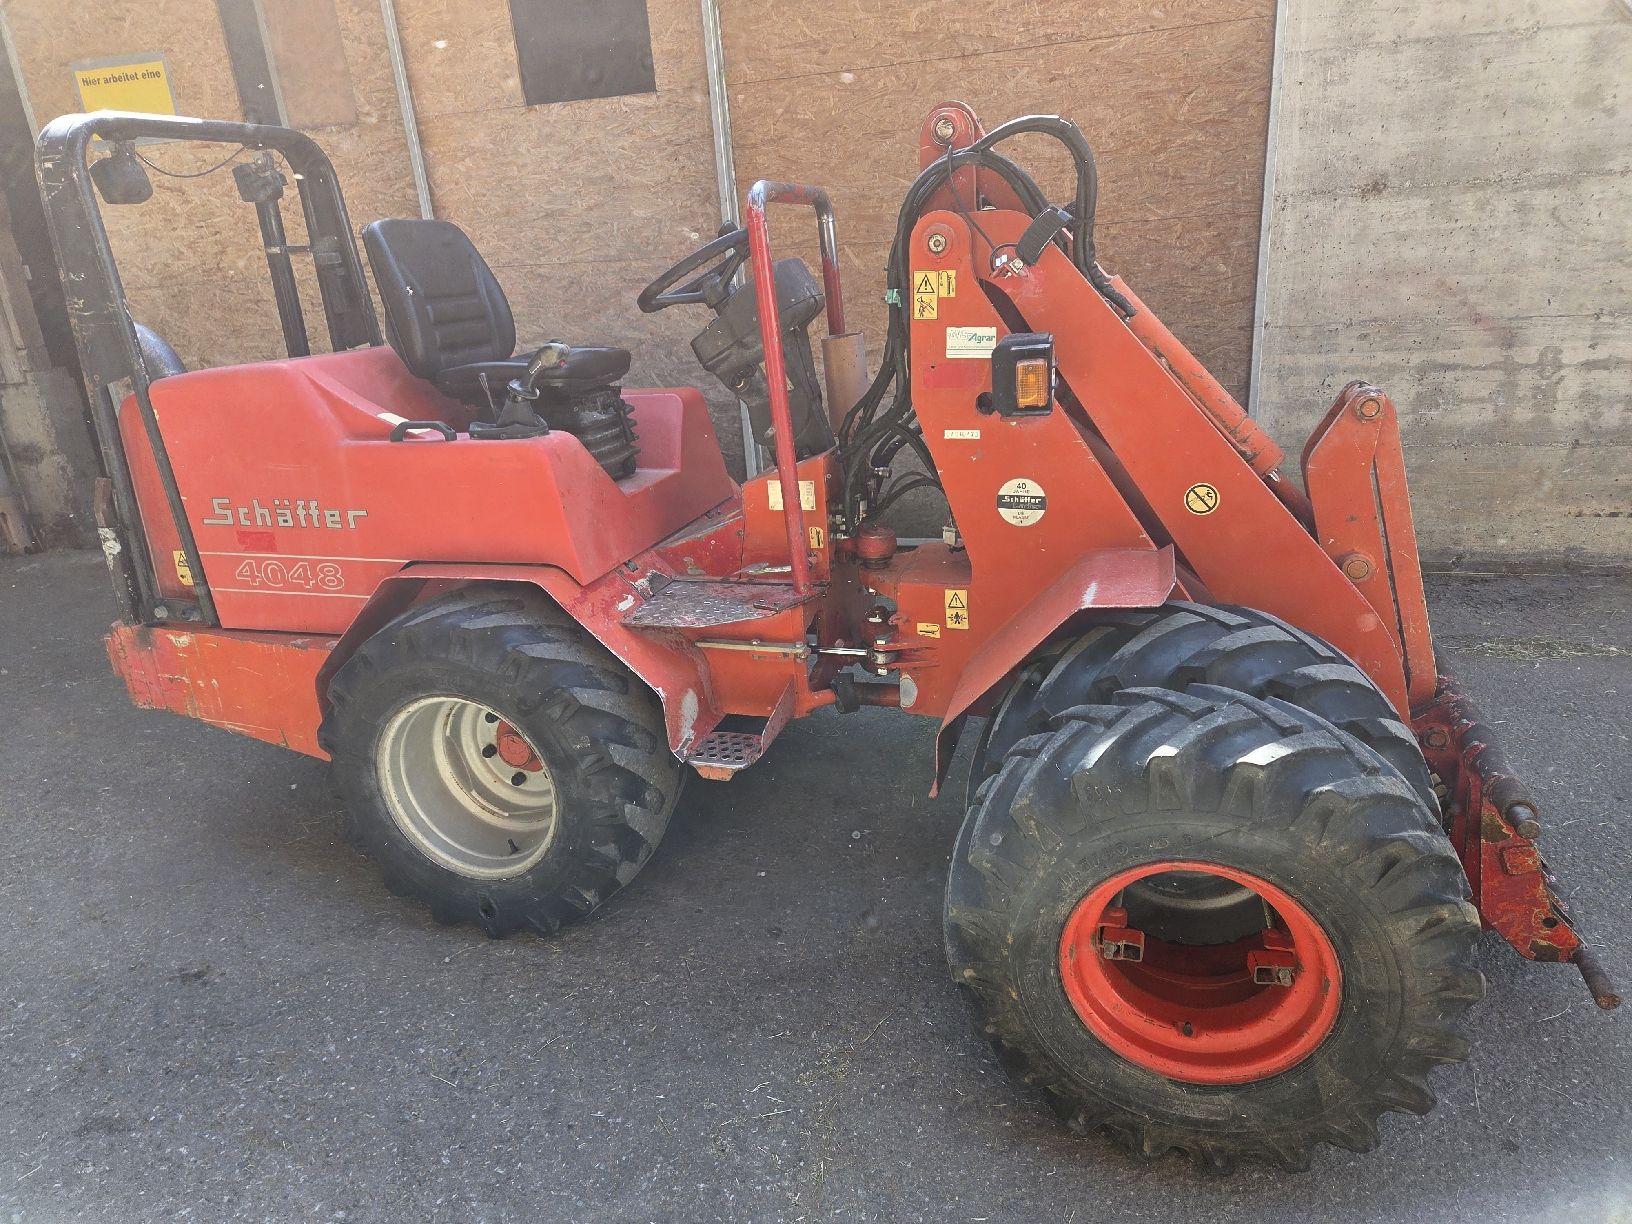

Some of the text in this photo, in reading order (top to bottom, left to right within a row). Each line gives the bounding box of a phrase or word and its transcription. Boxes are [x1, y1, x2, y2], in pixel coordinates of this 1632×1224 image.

[81, 69, 161, 87] Hier arbeitet eine
[968, 332, 996, 344] Agrar
[202, 497, 368, 530] Schäffer
[235, 559, 345, 591] 4048
